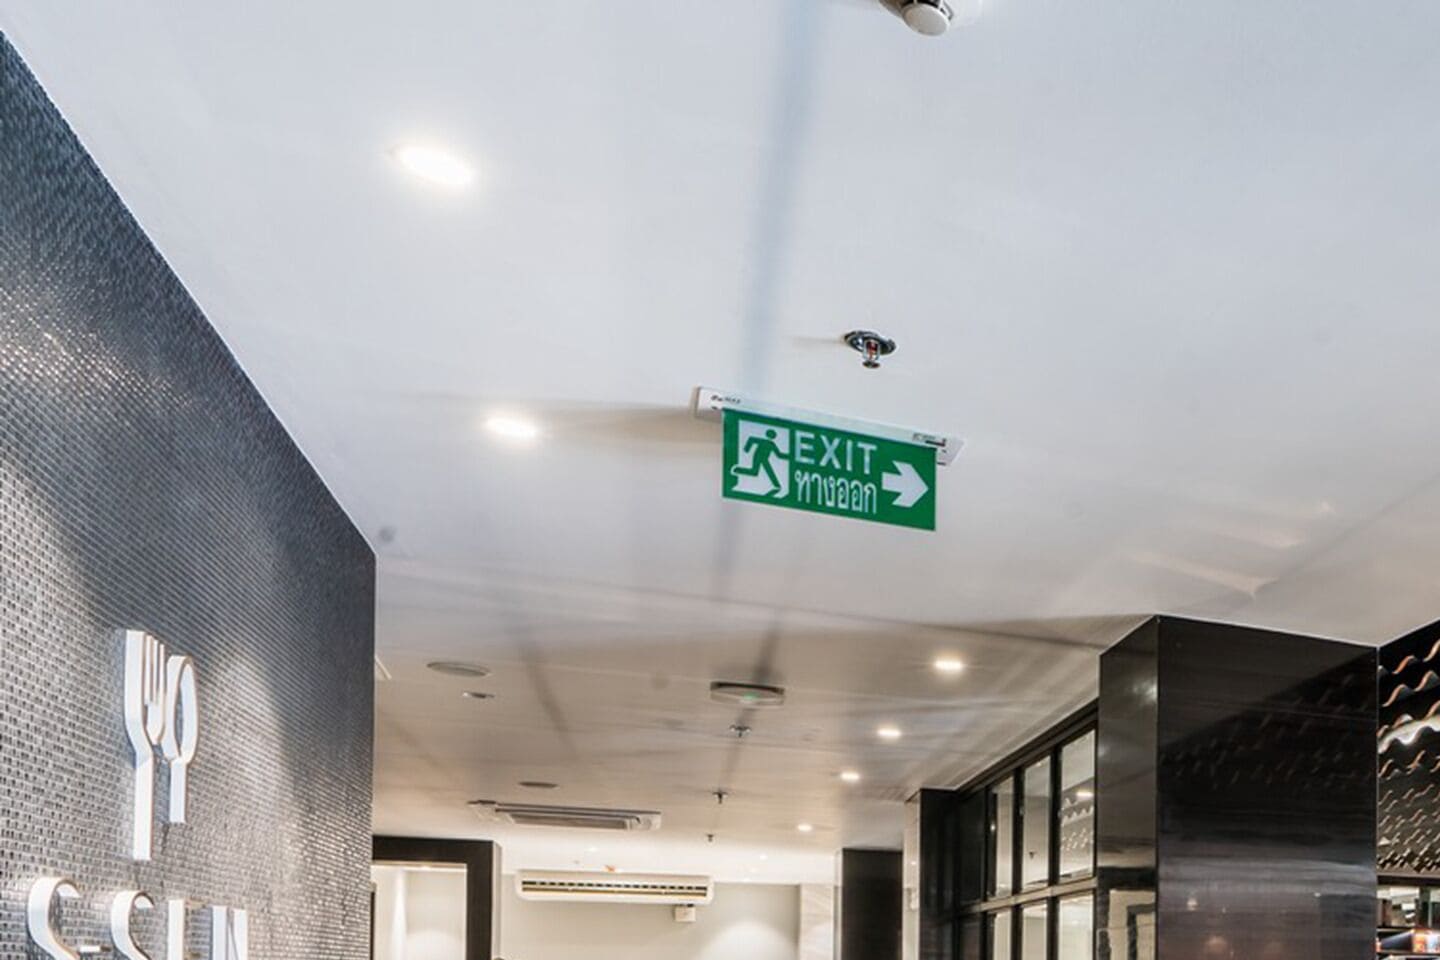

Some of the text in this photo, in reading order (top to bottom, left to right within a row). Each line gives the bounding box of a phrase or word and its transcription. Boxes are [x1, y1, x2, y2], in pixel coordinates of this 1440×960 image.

[795, 430, 877, 475] EXIT
[794, 469, 877, 514] ทางออก
